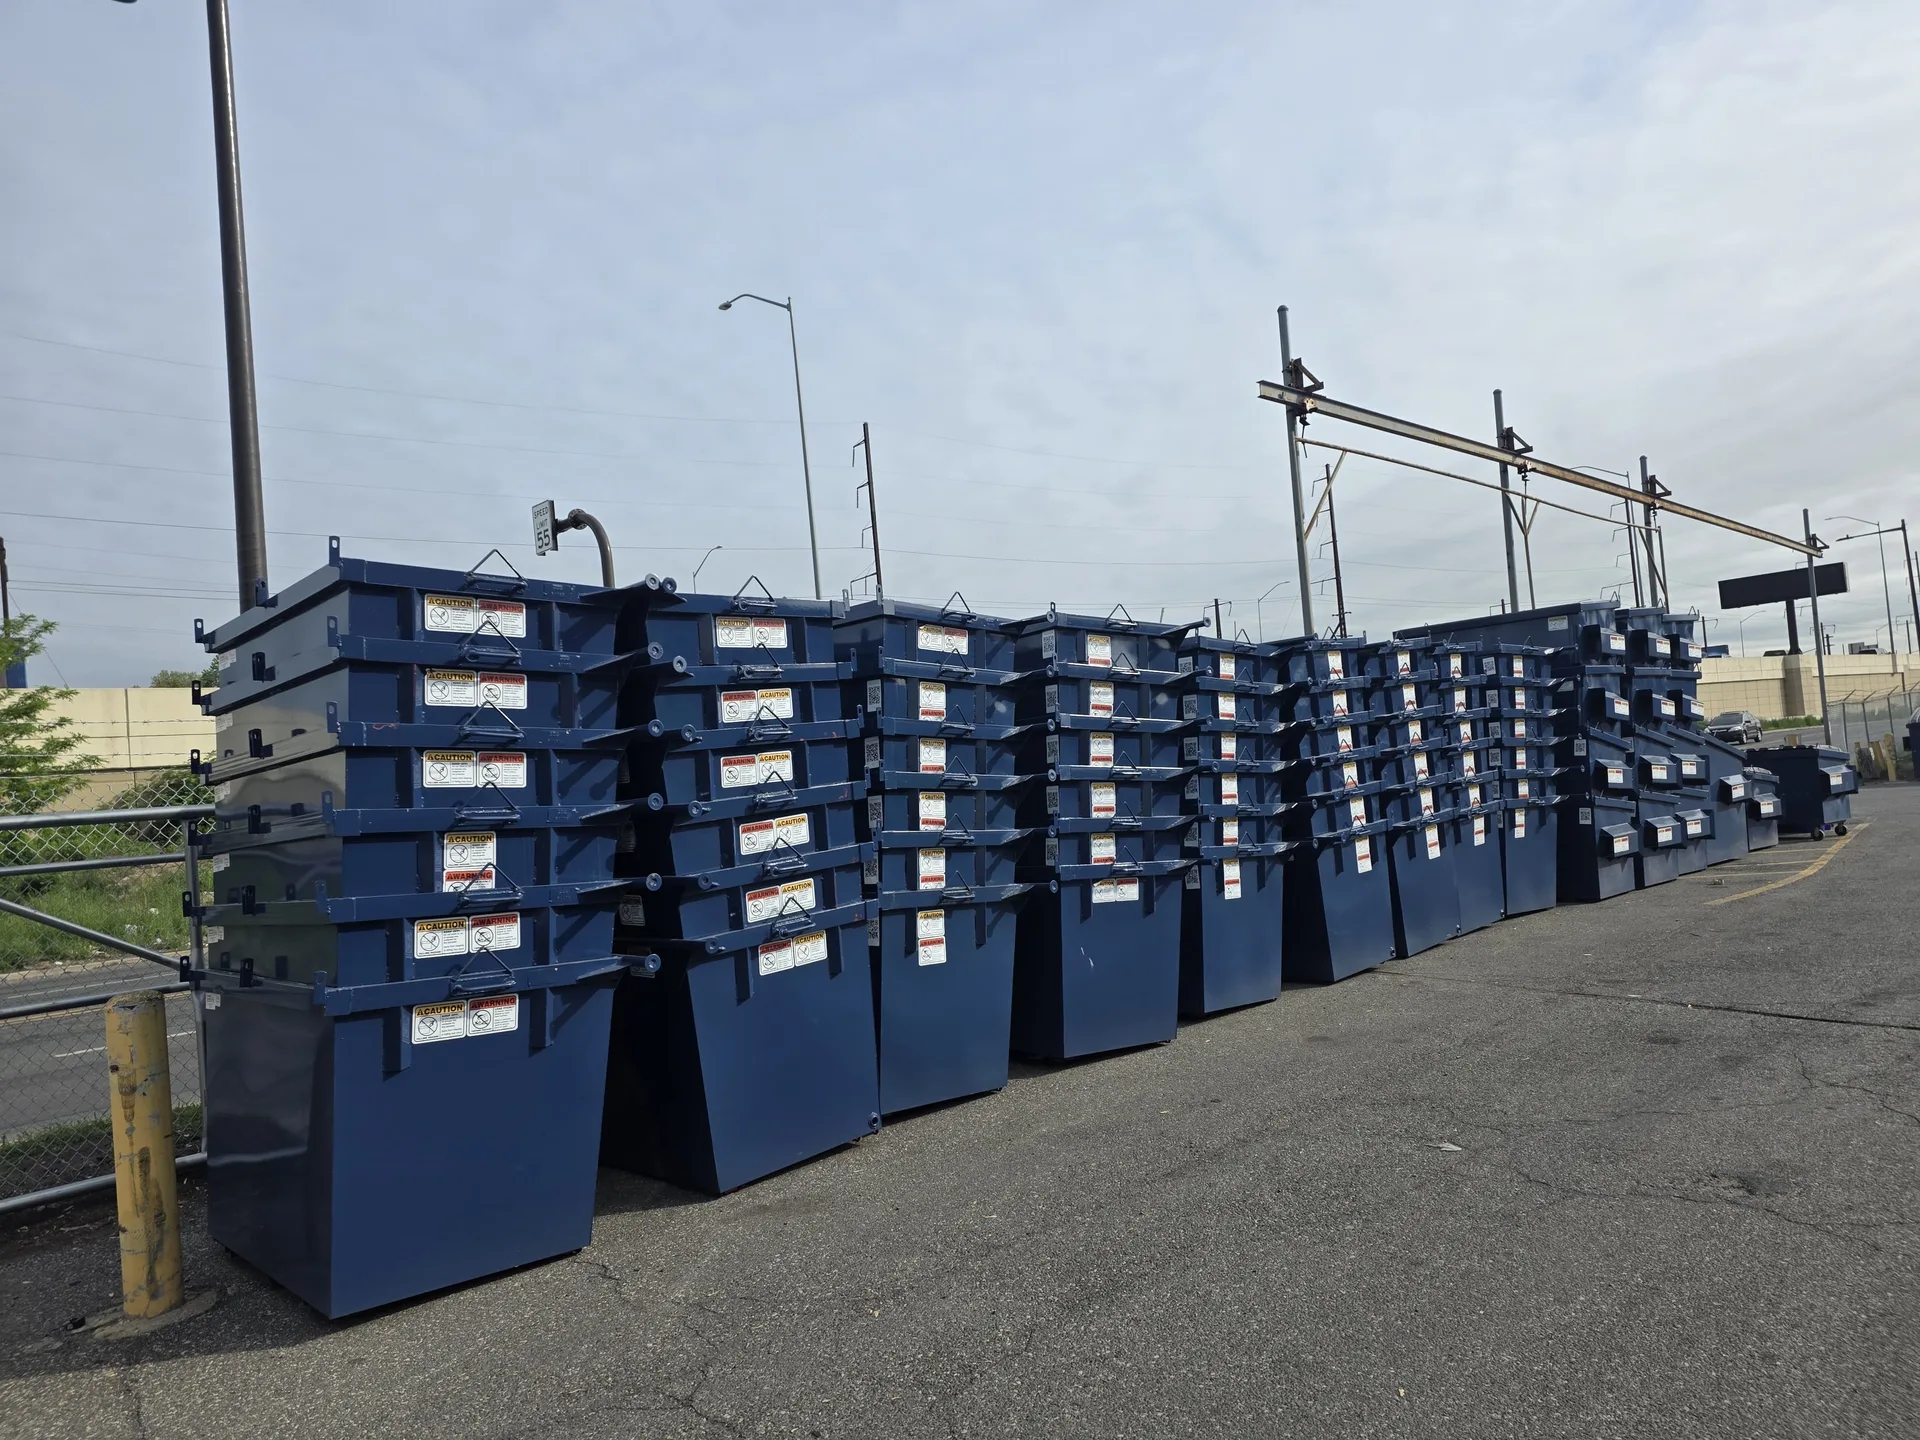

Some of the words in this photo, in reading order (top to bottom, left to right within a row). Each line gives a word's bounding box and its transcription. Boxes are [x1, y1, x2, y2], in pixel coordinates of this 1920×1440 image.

[534, 506, 548, 519] SPEED
[536, 518, 548, 530] LIMIT
[536, 528, 551, 549] 55
[435, 598, 472, 607] CAUTION
[486, 603, 523, 612] WARNING
[435, 672, 473, 681] CAUTION
[486, 675, 523, 684] WARNING
[434, 753, 472, 761] CAUTION
[781, 817, 806, 826] CAUTION
[746, 823, 773, 832] WARNING
[455, 835, 492, 843] CAUTION
[453, 872, 491, 880] WARNNG
[787, 882, 812, 892] CAUTION
[425, 920, 464, 930] CAUTION
[478, 916, 517, 925] WARNING
[800, 933, 824, 943] CAUTION
[477, 997, 515, 1008] WARNING
[424, 1004, 463, 1015] CAUTION
